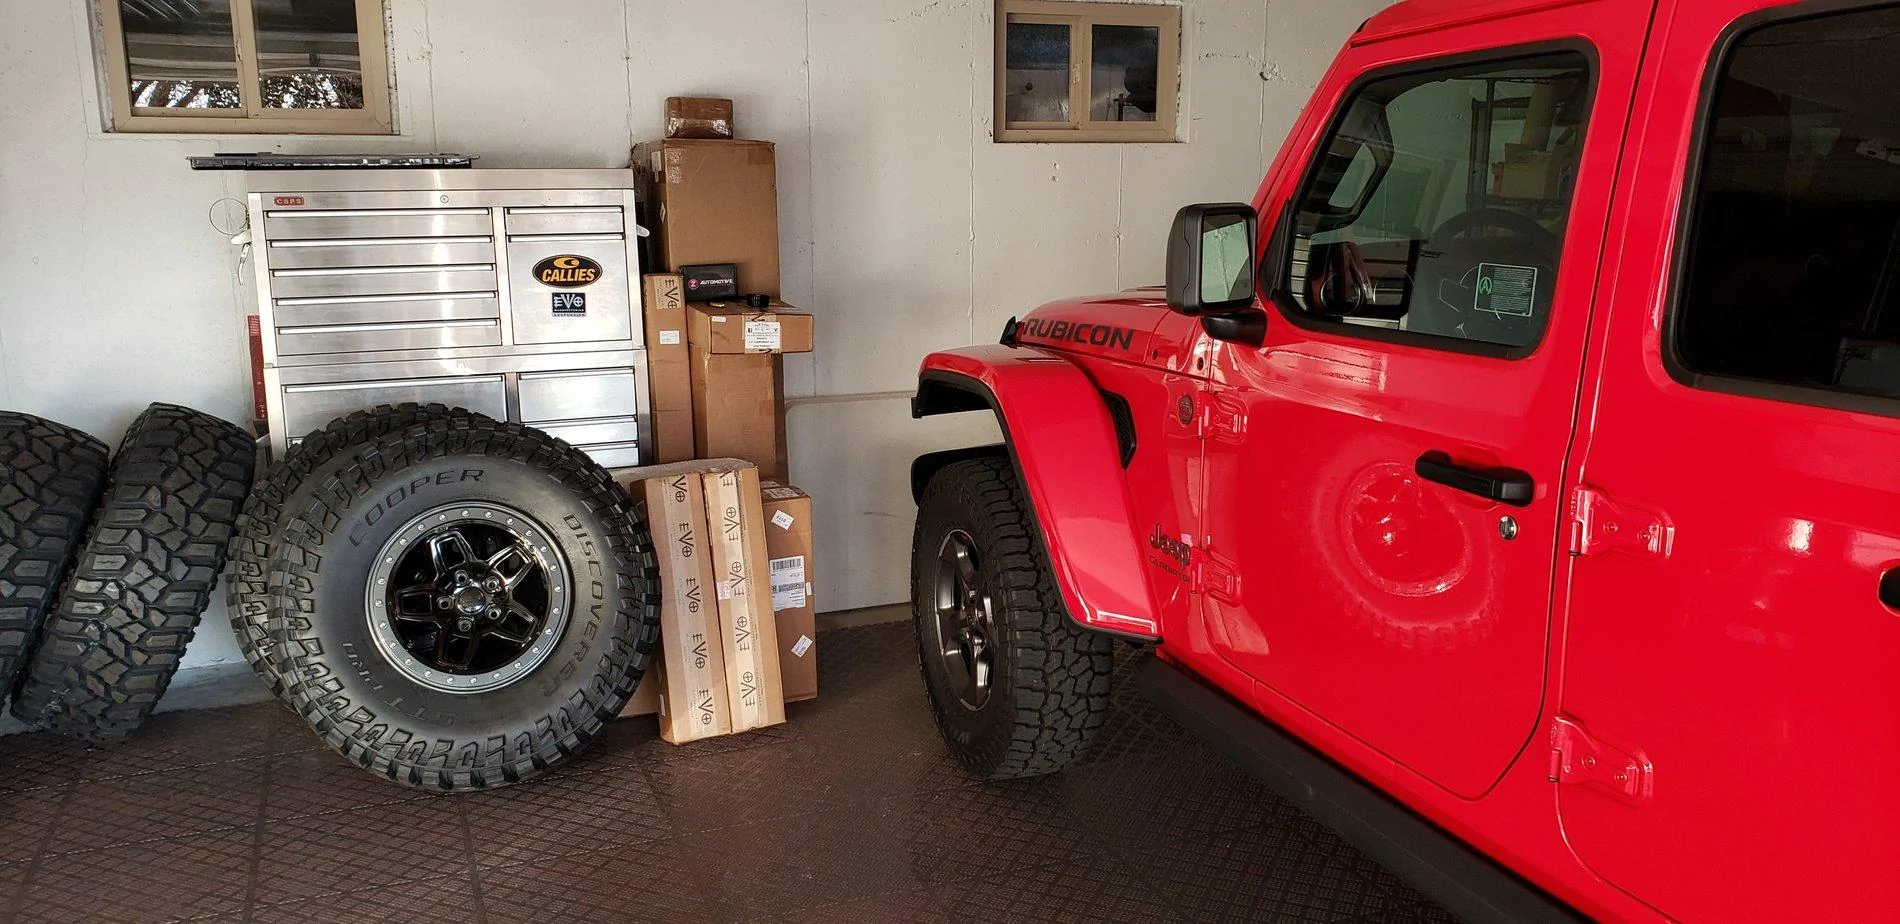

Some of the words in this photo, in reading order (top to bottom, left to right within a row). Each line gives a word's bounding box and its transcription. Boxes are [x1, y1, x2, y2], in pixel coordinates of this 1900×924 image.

[542, 268, 596, 282] CALLIES
[553, 293, 584, 308] EVO
[664, 279, 680, 310] EVO
[1023, 319, 1135, 350] RUBICON
[348, 469, 484, 547] COOPER
[724, 506, 740, 542] EVO
[679, 522, 695, 558] EVO
[1150, 522, 1191, 568] Jeep
[685, 577, 701, 613] EVO
[729, 561, 747, 597] EVO
[543, 513, 604, 698] DISCOVERER
[691, 633, 708, 669] EVO
[735, 616, 752, 651] EVO
[698, 689, 714, 725] EVO
[741, 671, 757, 707] EVO
